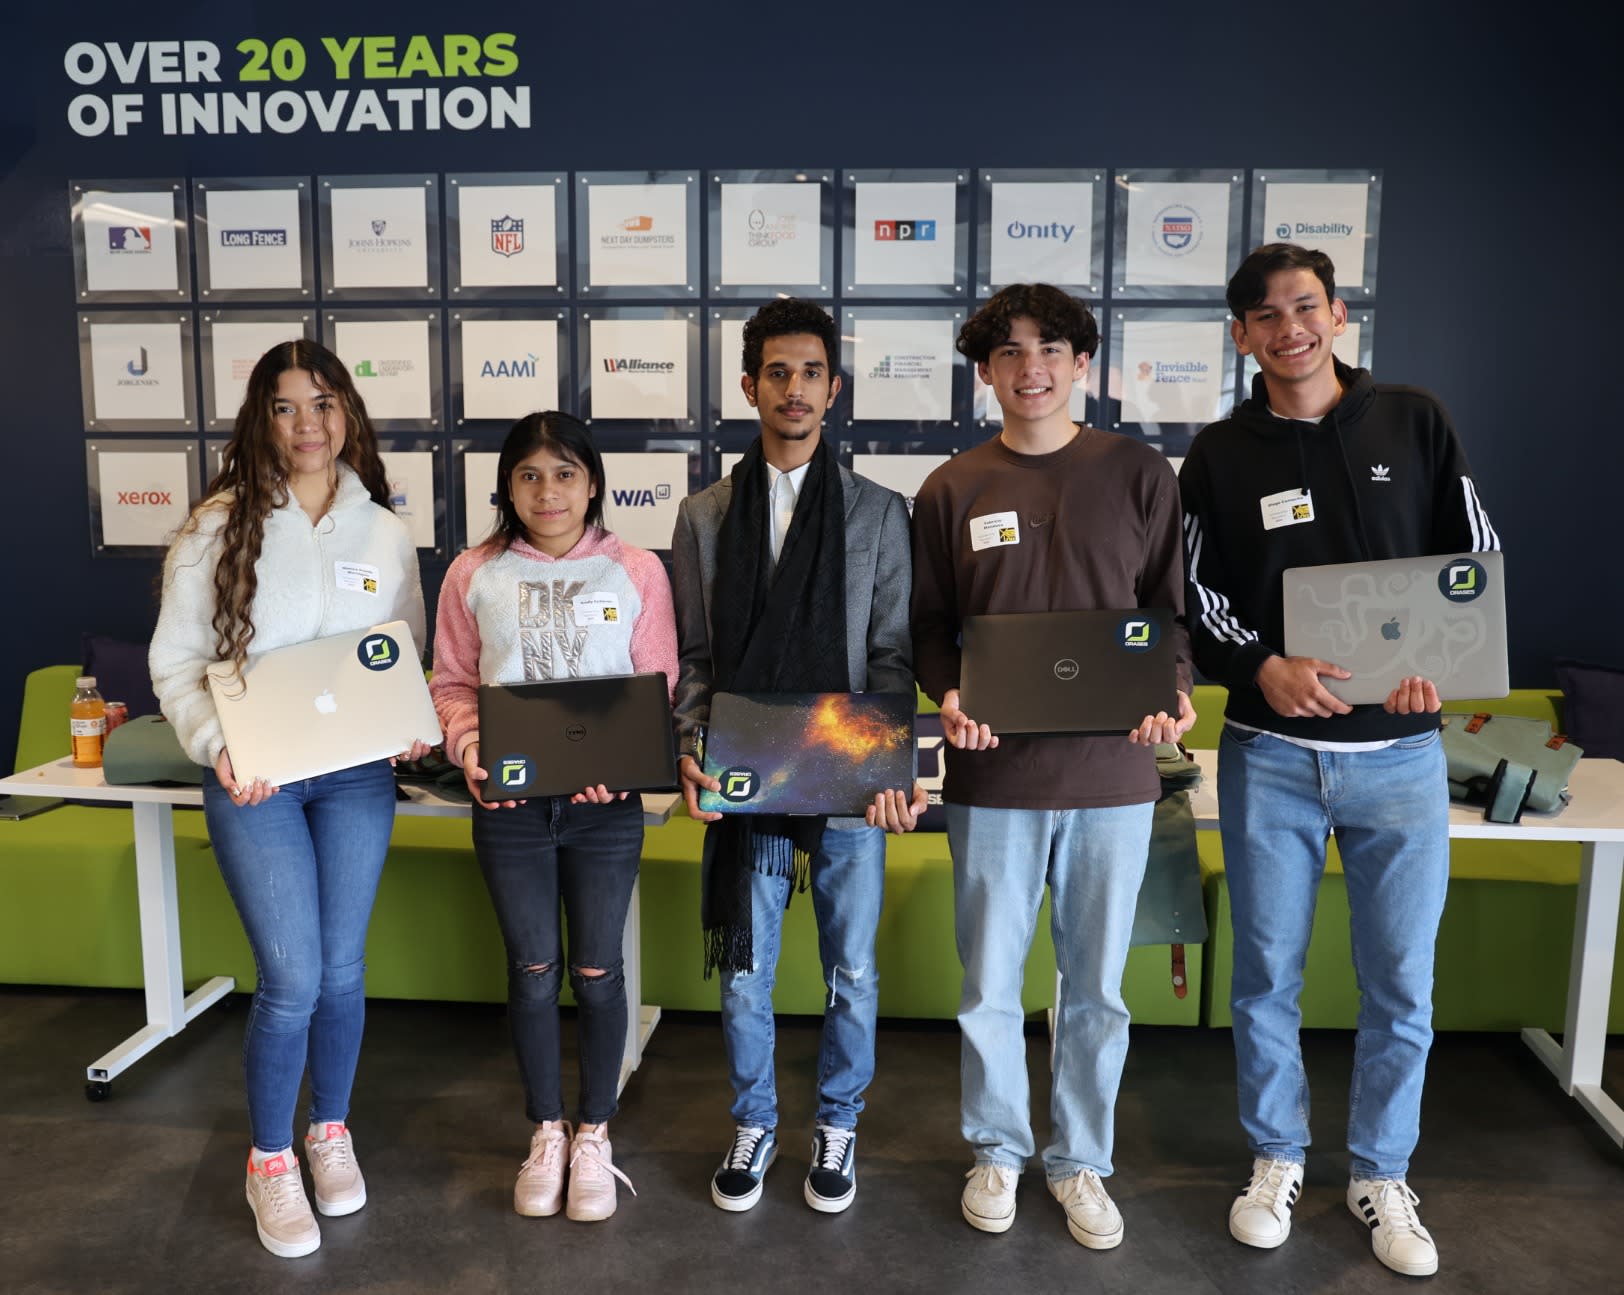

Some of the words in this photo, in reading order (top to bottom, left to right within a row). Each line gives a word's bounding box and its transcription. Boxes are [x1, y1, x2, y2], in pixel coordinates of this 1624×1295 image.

[64, 41, 222, 86] OVER
[236, 38, 306, 82] 20
[321, 33, 519, 80] YEARS
[67, 94, 144, 137] OF
[161, 86, 532, 135] INNOVATION
[879, 223, 930, 239] npr
[1007, 220, 1076, 243] Onity
[1295, 222, 1353, 236] Disability
[223, 231, 250, 246] LONG
[252, 230, 286, 245] FENCE
[495, 233, 522, 253] NFL
[601, 235, 618, 245] NEXT
[619, 235, 633, 245] DAY
[633, 234, 675, 244] DUMPSTERS
[480, 360, 535, 378] AAMI
[616, 358, 675, 370] Alliance
[1155, 361, 1208, 373] Invisible
[1155, 373, 1191, 384] Fence
[118, 491, 171, 505] xerox
[519, 579, 587, 629] DK
[520, 631, 588, 682] NY
